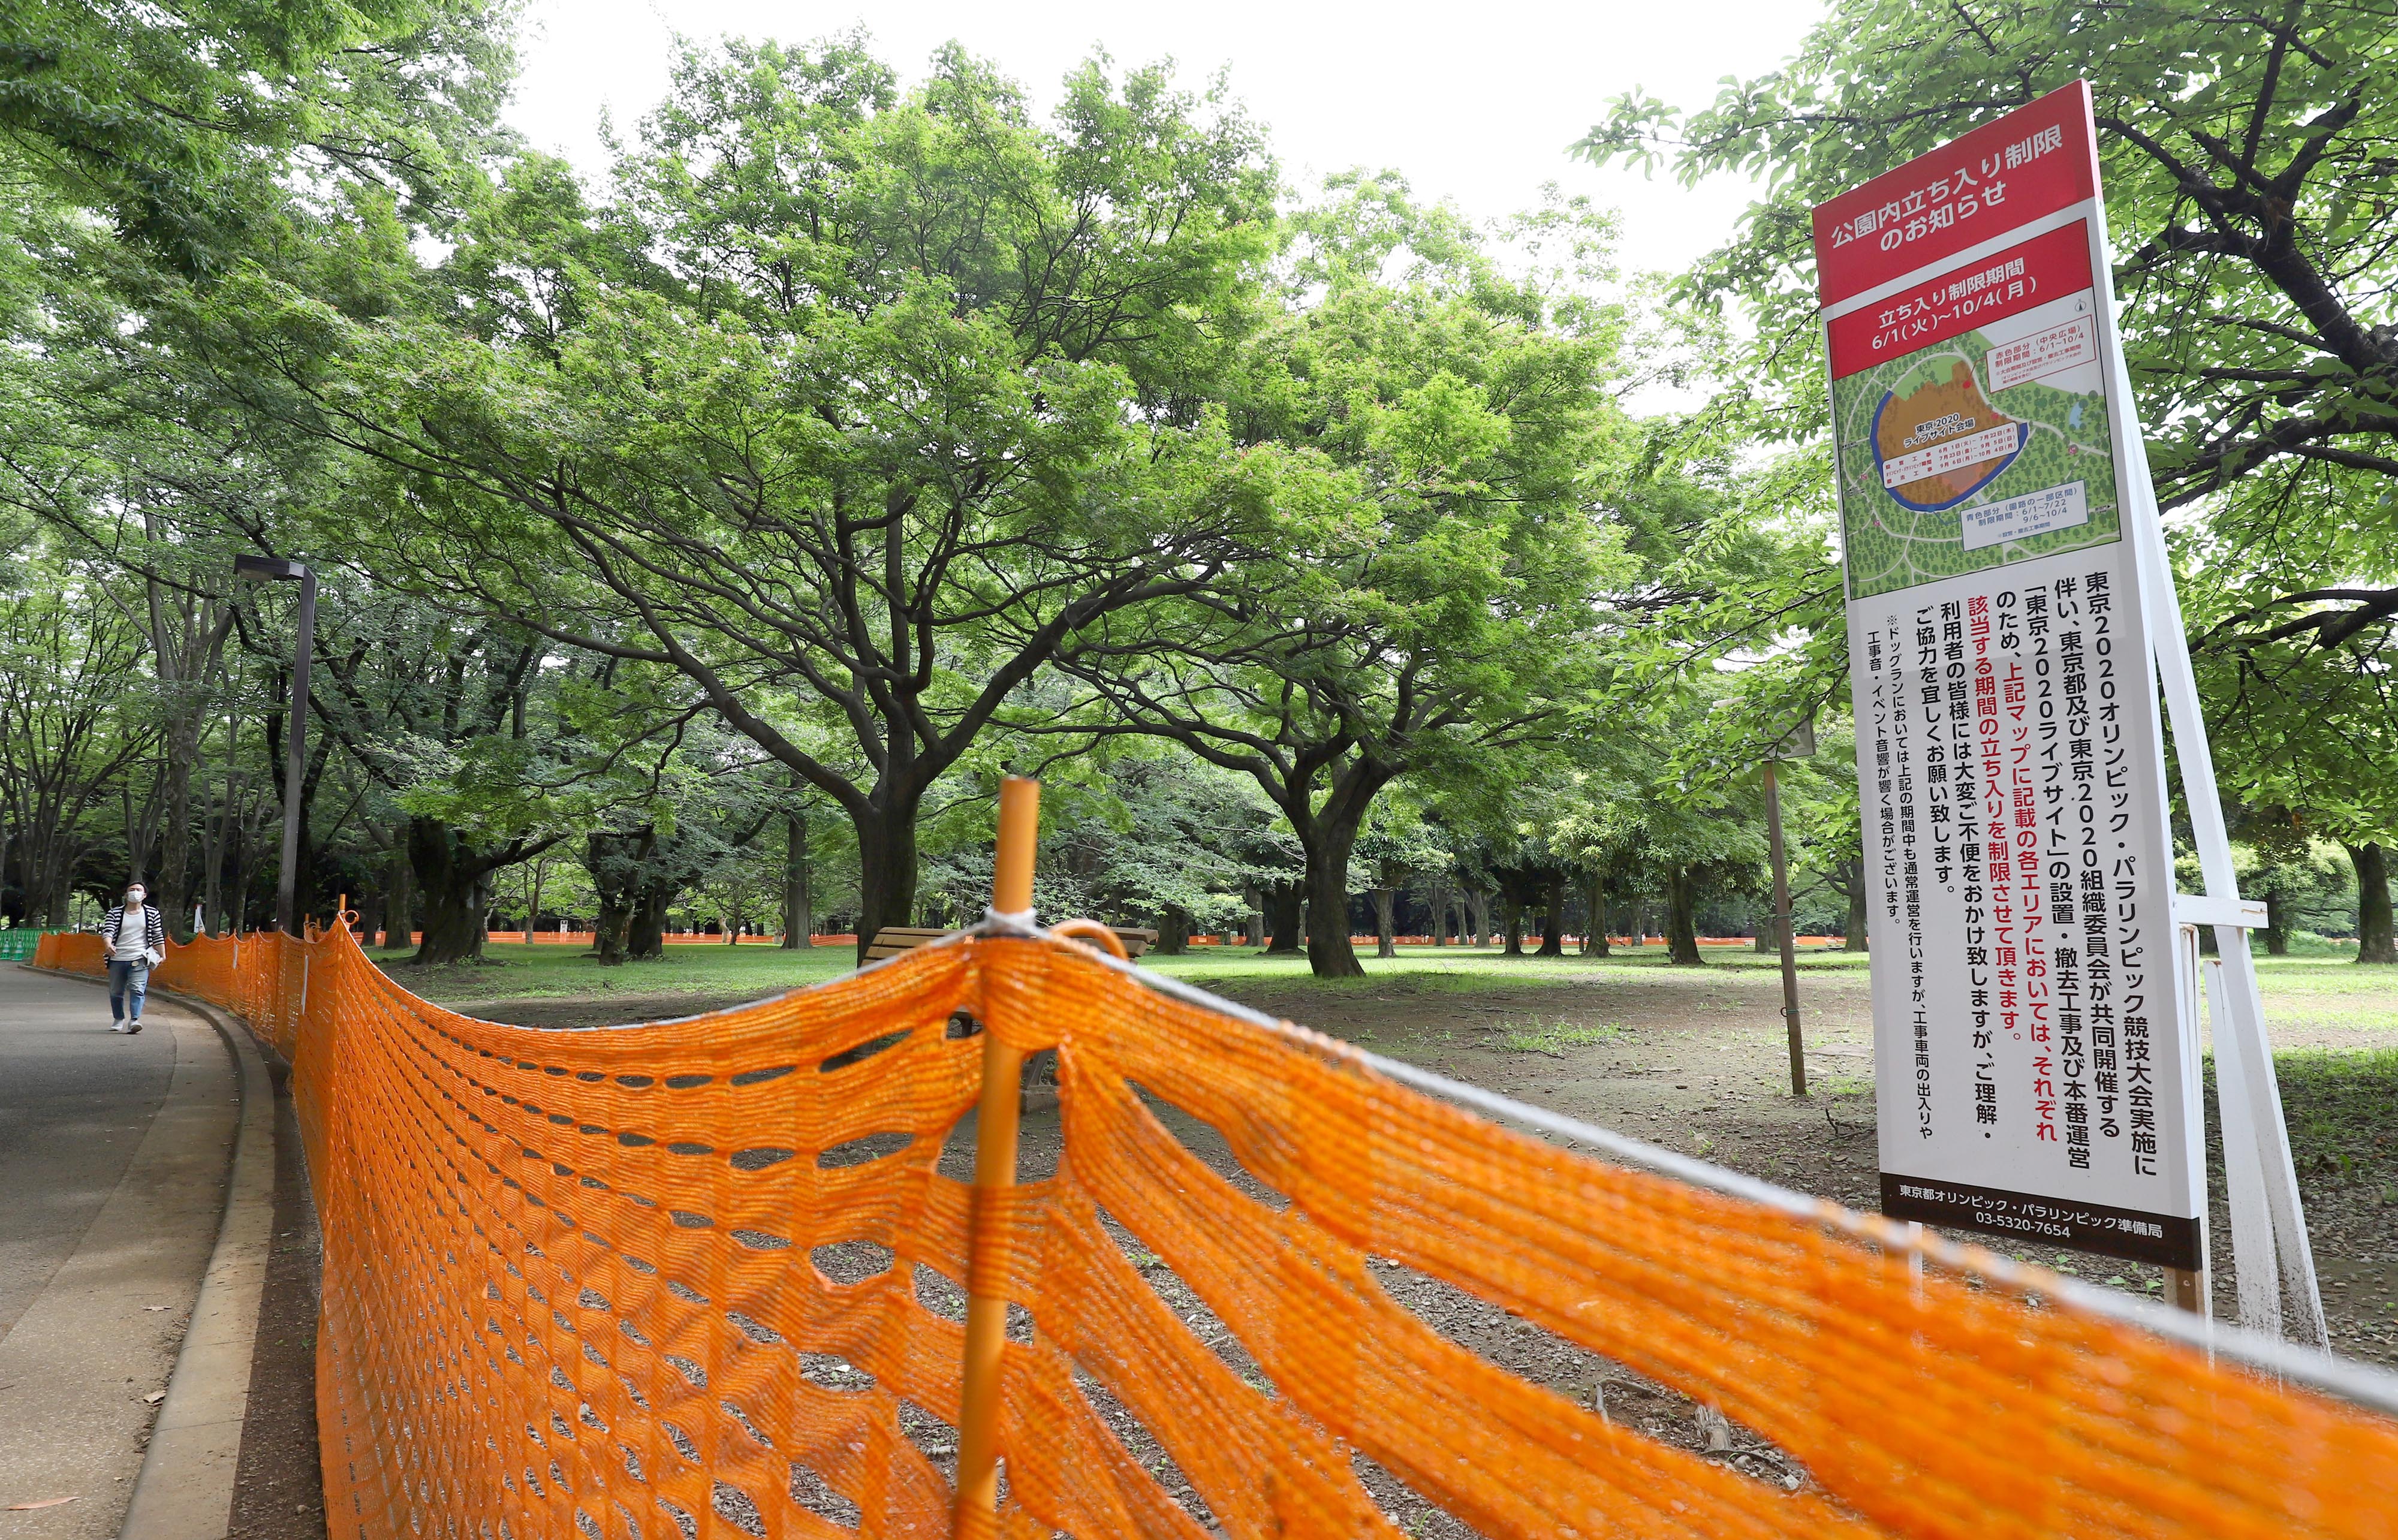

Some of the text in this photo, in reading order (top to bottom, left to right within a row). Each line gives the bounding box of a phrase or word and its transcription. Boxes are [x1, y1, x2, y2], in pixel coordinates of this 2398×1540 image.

[1831, 123, 2063, 249] 公園内立ち入り制限
[1881, 181, 2007, 251] のお知らせ
[1879, 257, 2025, 329] 立ち入り制限期間
[1905, 418, 1974, 447] ライブサイト会場
[1916, 414, 1959, 434] 東京 2020
[1867, 631, 1900, 924] 工事音・イベント音響が響く場合がございます。
[1917, 605, 1954, 893] ご協力を宜しくお願い致します。
[1941, 600, 1997, 1138] 利用者の皆様には大変ご不便をおかけ致しますが、ご理解・
[1968, 595, 2020, 1041] 該当する期間の立ち入りを制限させて頂きます。
[2054, 577, 2120, 1138] 伴い、東京都及び東京2020組織委員会が共同開催する
[2084, 571, 2157, 1176] 東京2020オリンピック・パラリンピック競技大会実施に
[1899, 1184, 2163, 1238] 東京都オリンピック・パラリンピック準備局
[1976, 1211, 2071, 1238] 03-5320-7654
